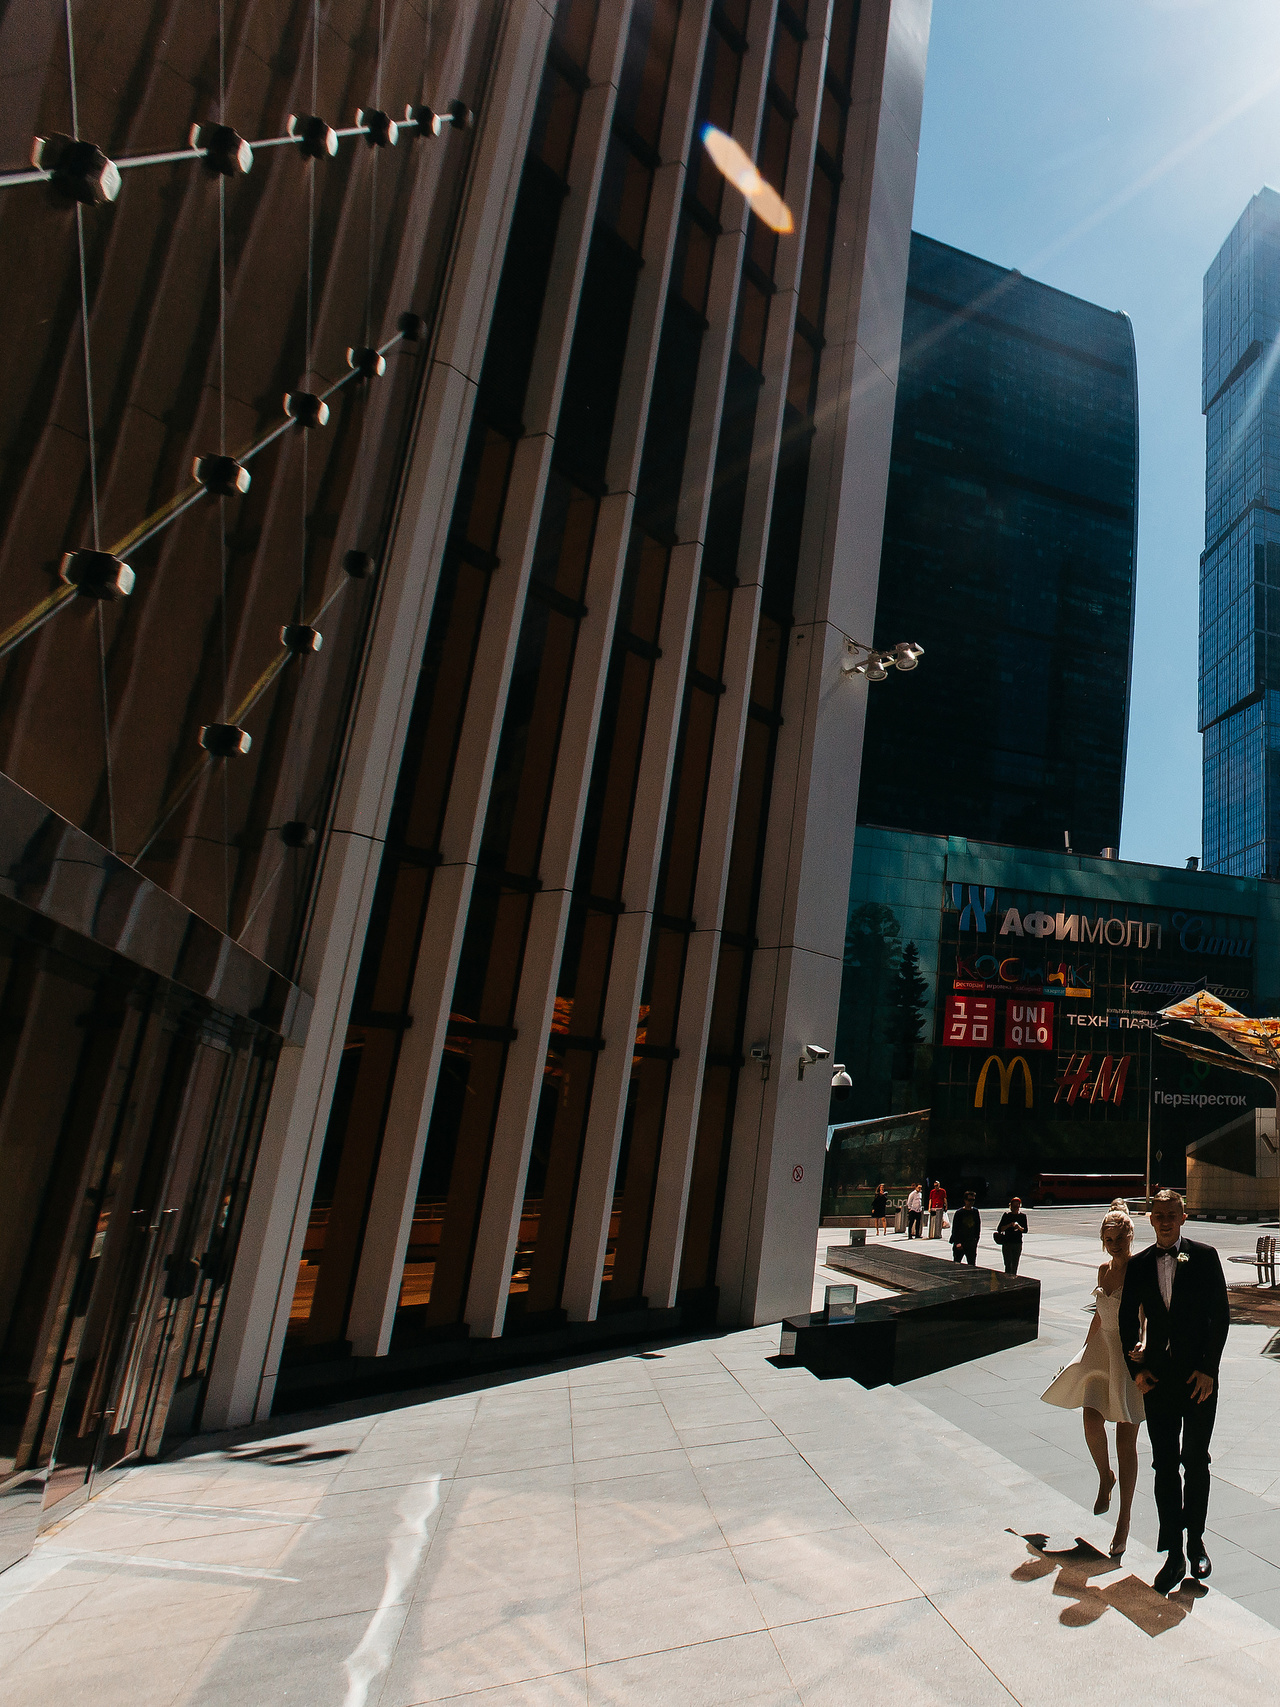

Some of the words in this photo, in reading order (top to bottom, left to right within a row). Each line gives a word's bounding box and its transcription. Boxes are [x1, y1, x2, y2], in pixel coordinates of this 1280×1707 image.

[999, 907, 1162, 950] АФИМОЛЛ
[955, 981, 984, 989] ресторан
[1012, 1005, 1046, 1024] UNI
[1011, 1025, 1048, 1045] QLO
[1054, 1053, 1131, 1107] H&M
[1154, 1090, 1247, 1108] Перекресток
